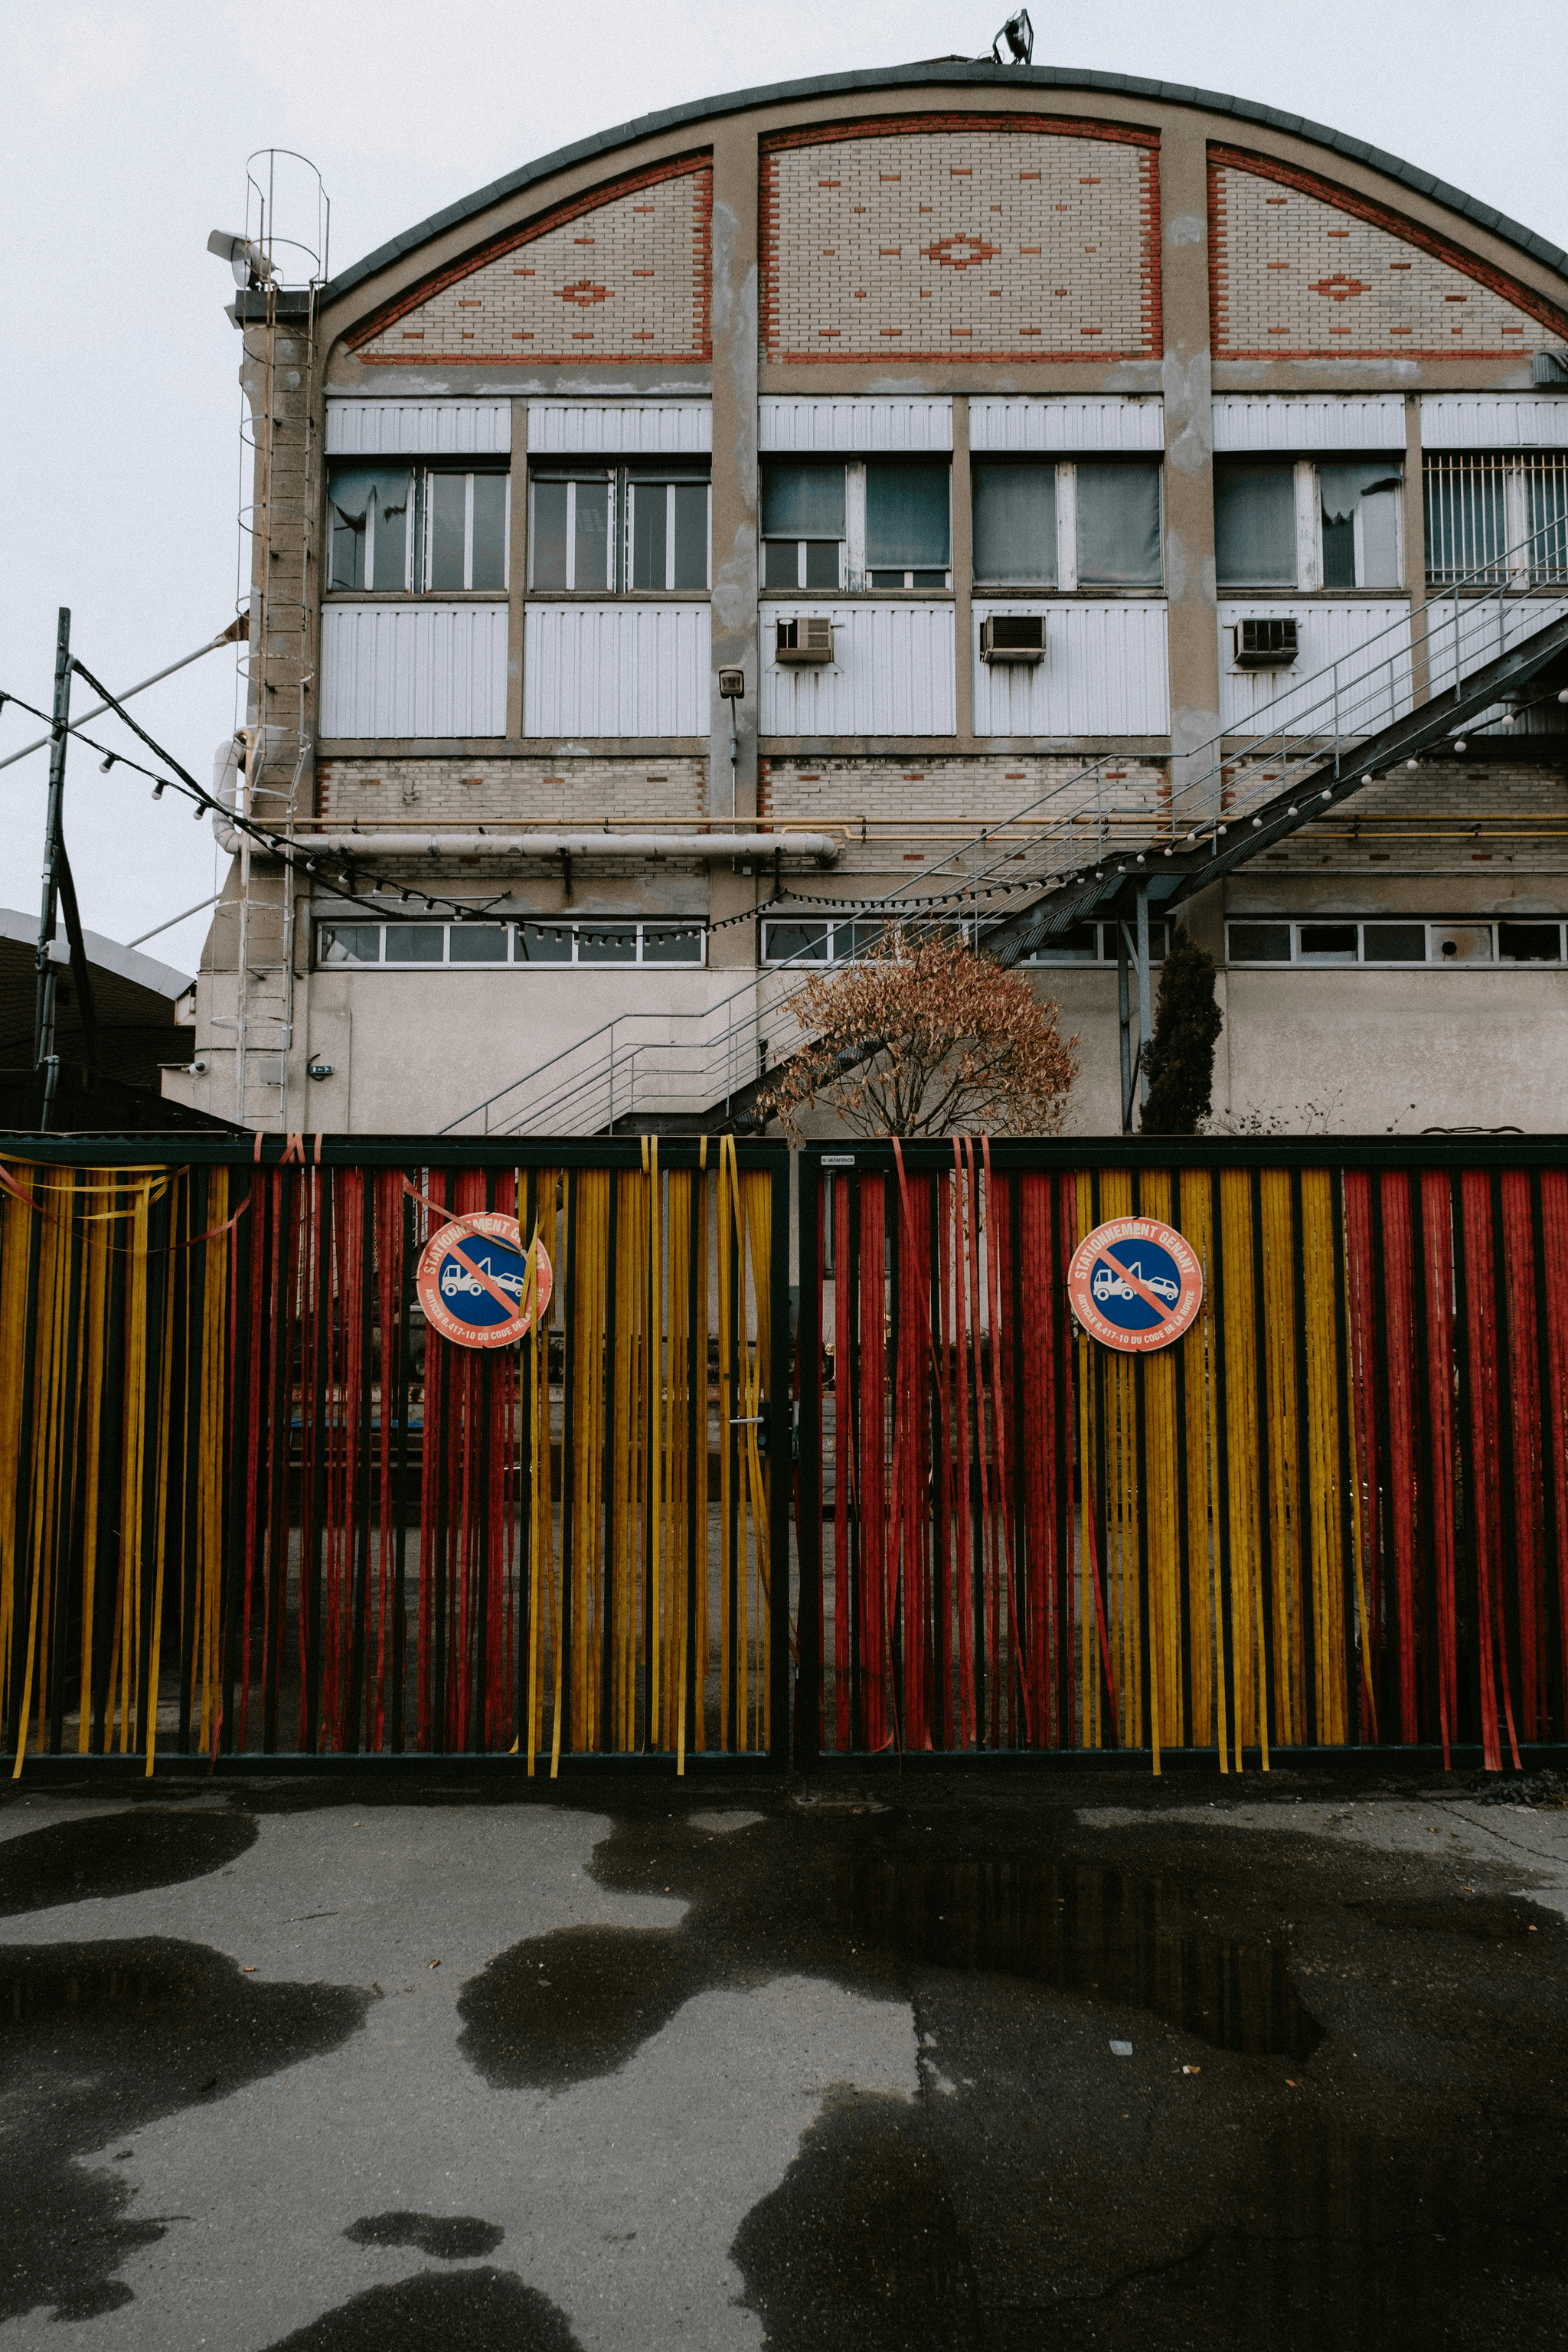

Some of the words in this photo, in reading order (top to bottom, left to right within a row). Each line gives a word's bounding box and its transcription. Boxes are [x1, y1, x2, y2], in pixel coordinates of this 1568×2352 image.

[423, 1218, 511, 1275] STATIONNMENT
[1074, 1223, 1158, 1279] STATIONNEMENT
[1158, 1231, 1196, 1273] GENANT
[425, 1289, 445, 1320] ARTICLE
[441, 1316, 475, 1340] R.417-10
[478, 1332, 488, 1341] DU
[491, 1327, 512, 1340] CODE
[511, 1318, 524, 1331] DE
[1077, 1293, 1097, 1324] ARTICLE
[1095, 1321, 1129, 1344] R.417-10
[1131, 1336, 1142, 1344] DU
[1144, 1330, 1165, 1344] CODE
[1164, 1322, 1176, 1335] DE
[1173, 1315, 1184, 1327] LA
[1180, 1290, 1195, 1315] ROUTE
